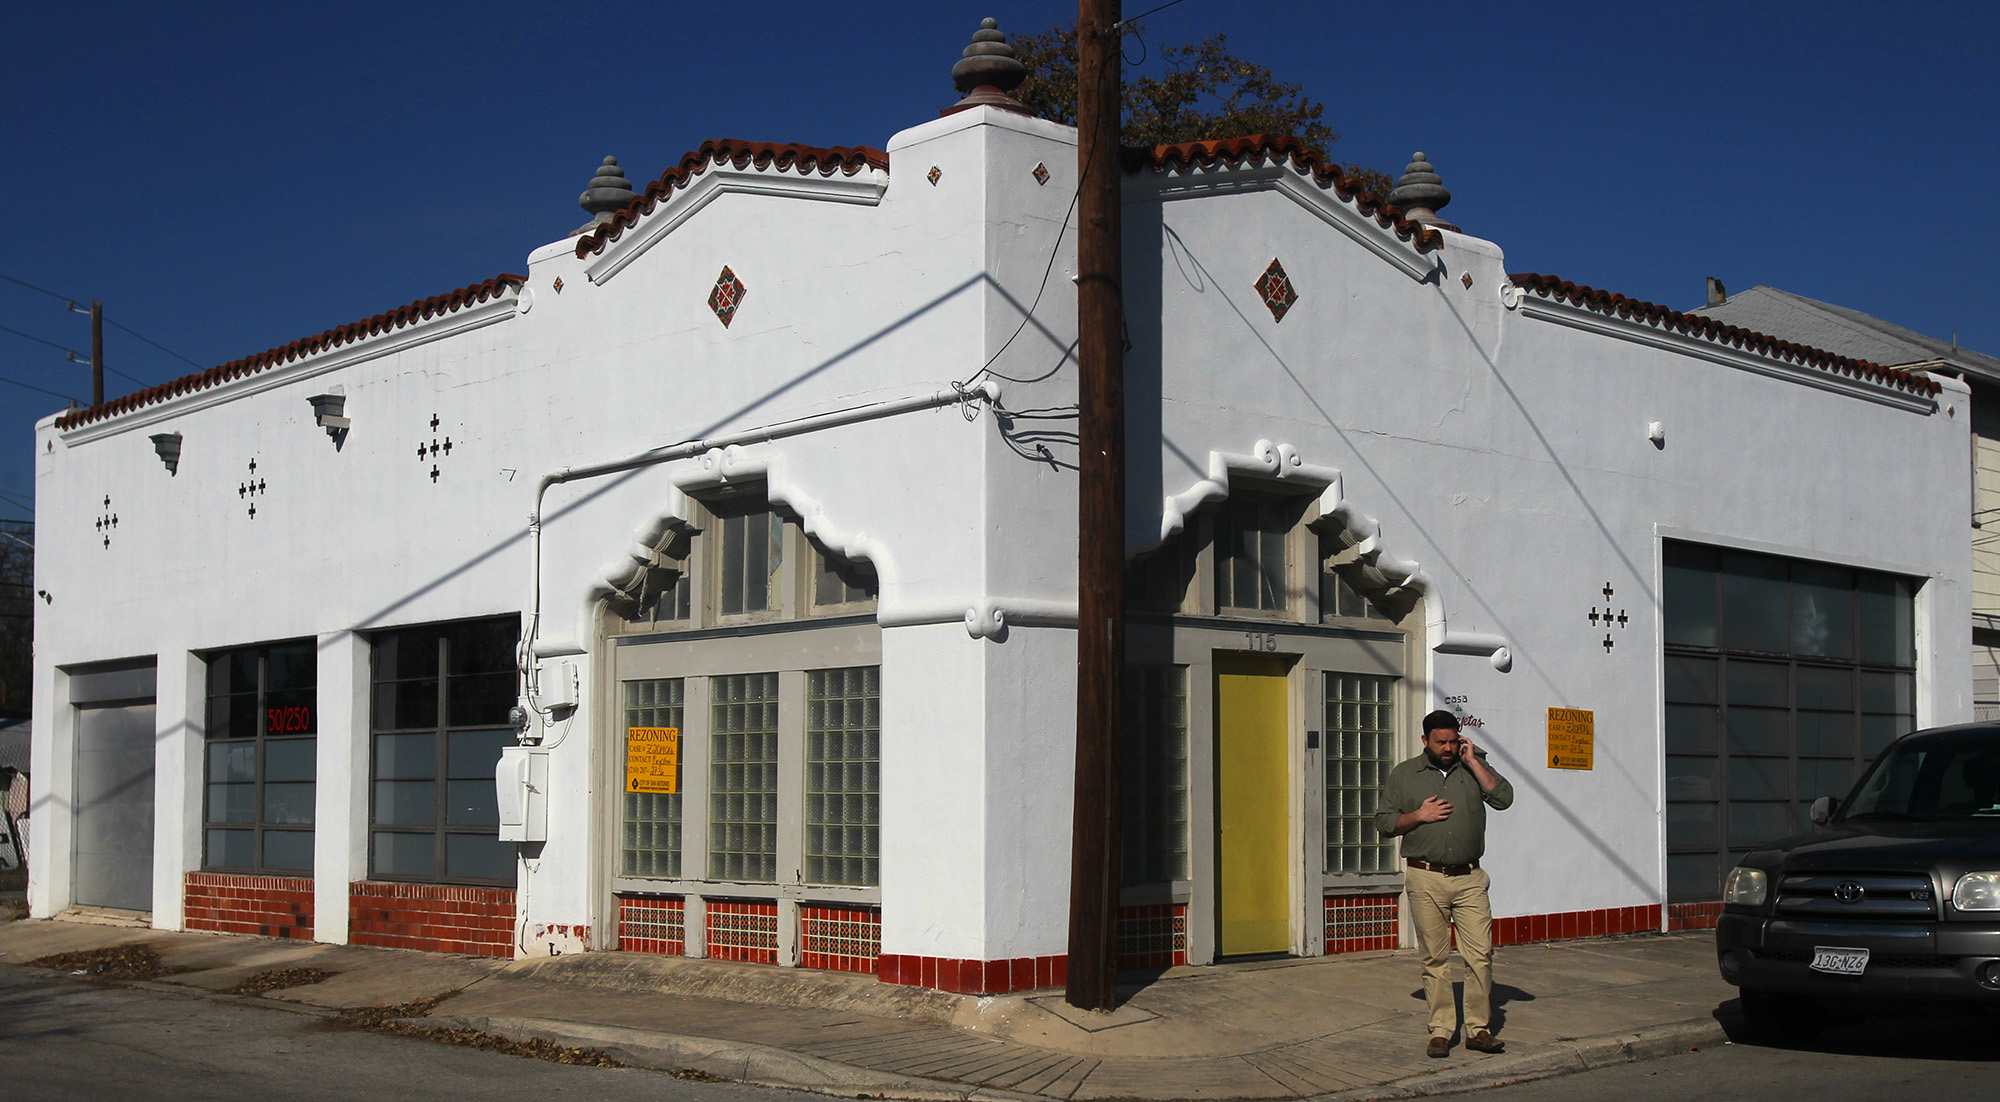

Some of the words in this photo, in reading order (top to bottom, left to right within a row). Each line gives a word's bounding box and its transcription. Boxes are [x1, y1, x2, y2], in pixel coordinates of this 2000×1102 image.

[1246, 632, 1277, 651] 115
[1444, 695, 1468, 704] casa
[268, 705, 310, 734] 50/250
[1549, 709, 1593, 724] REZONING
[630, 729, 676, 742] REZONING
[1549, 734, 1571, 742] CONTACT
[1910, 891, 1929, 900] V8
